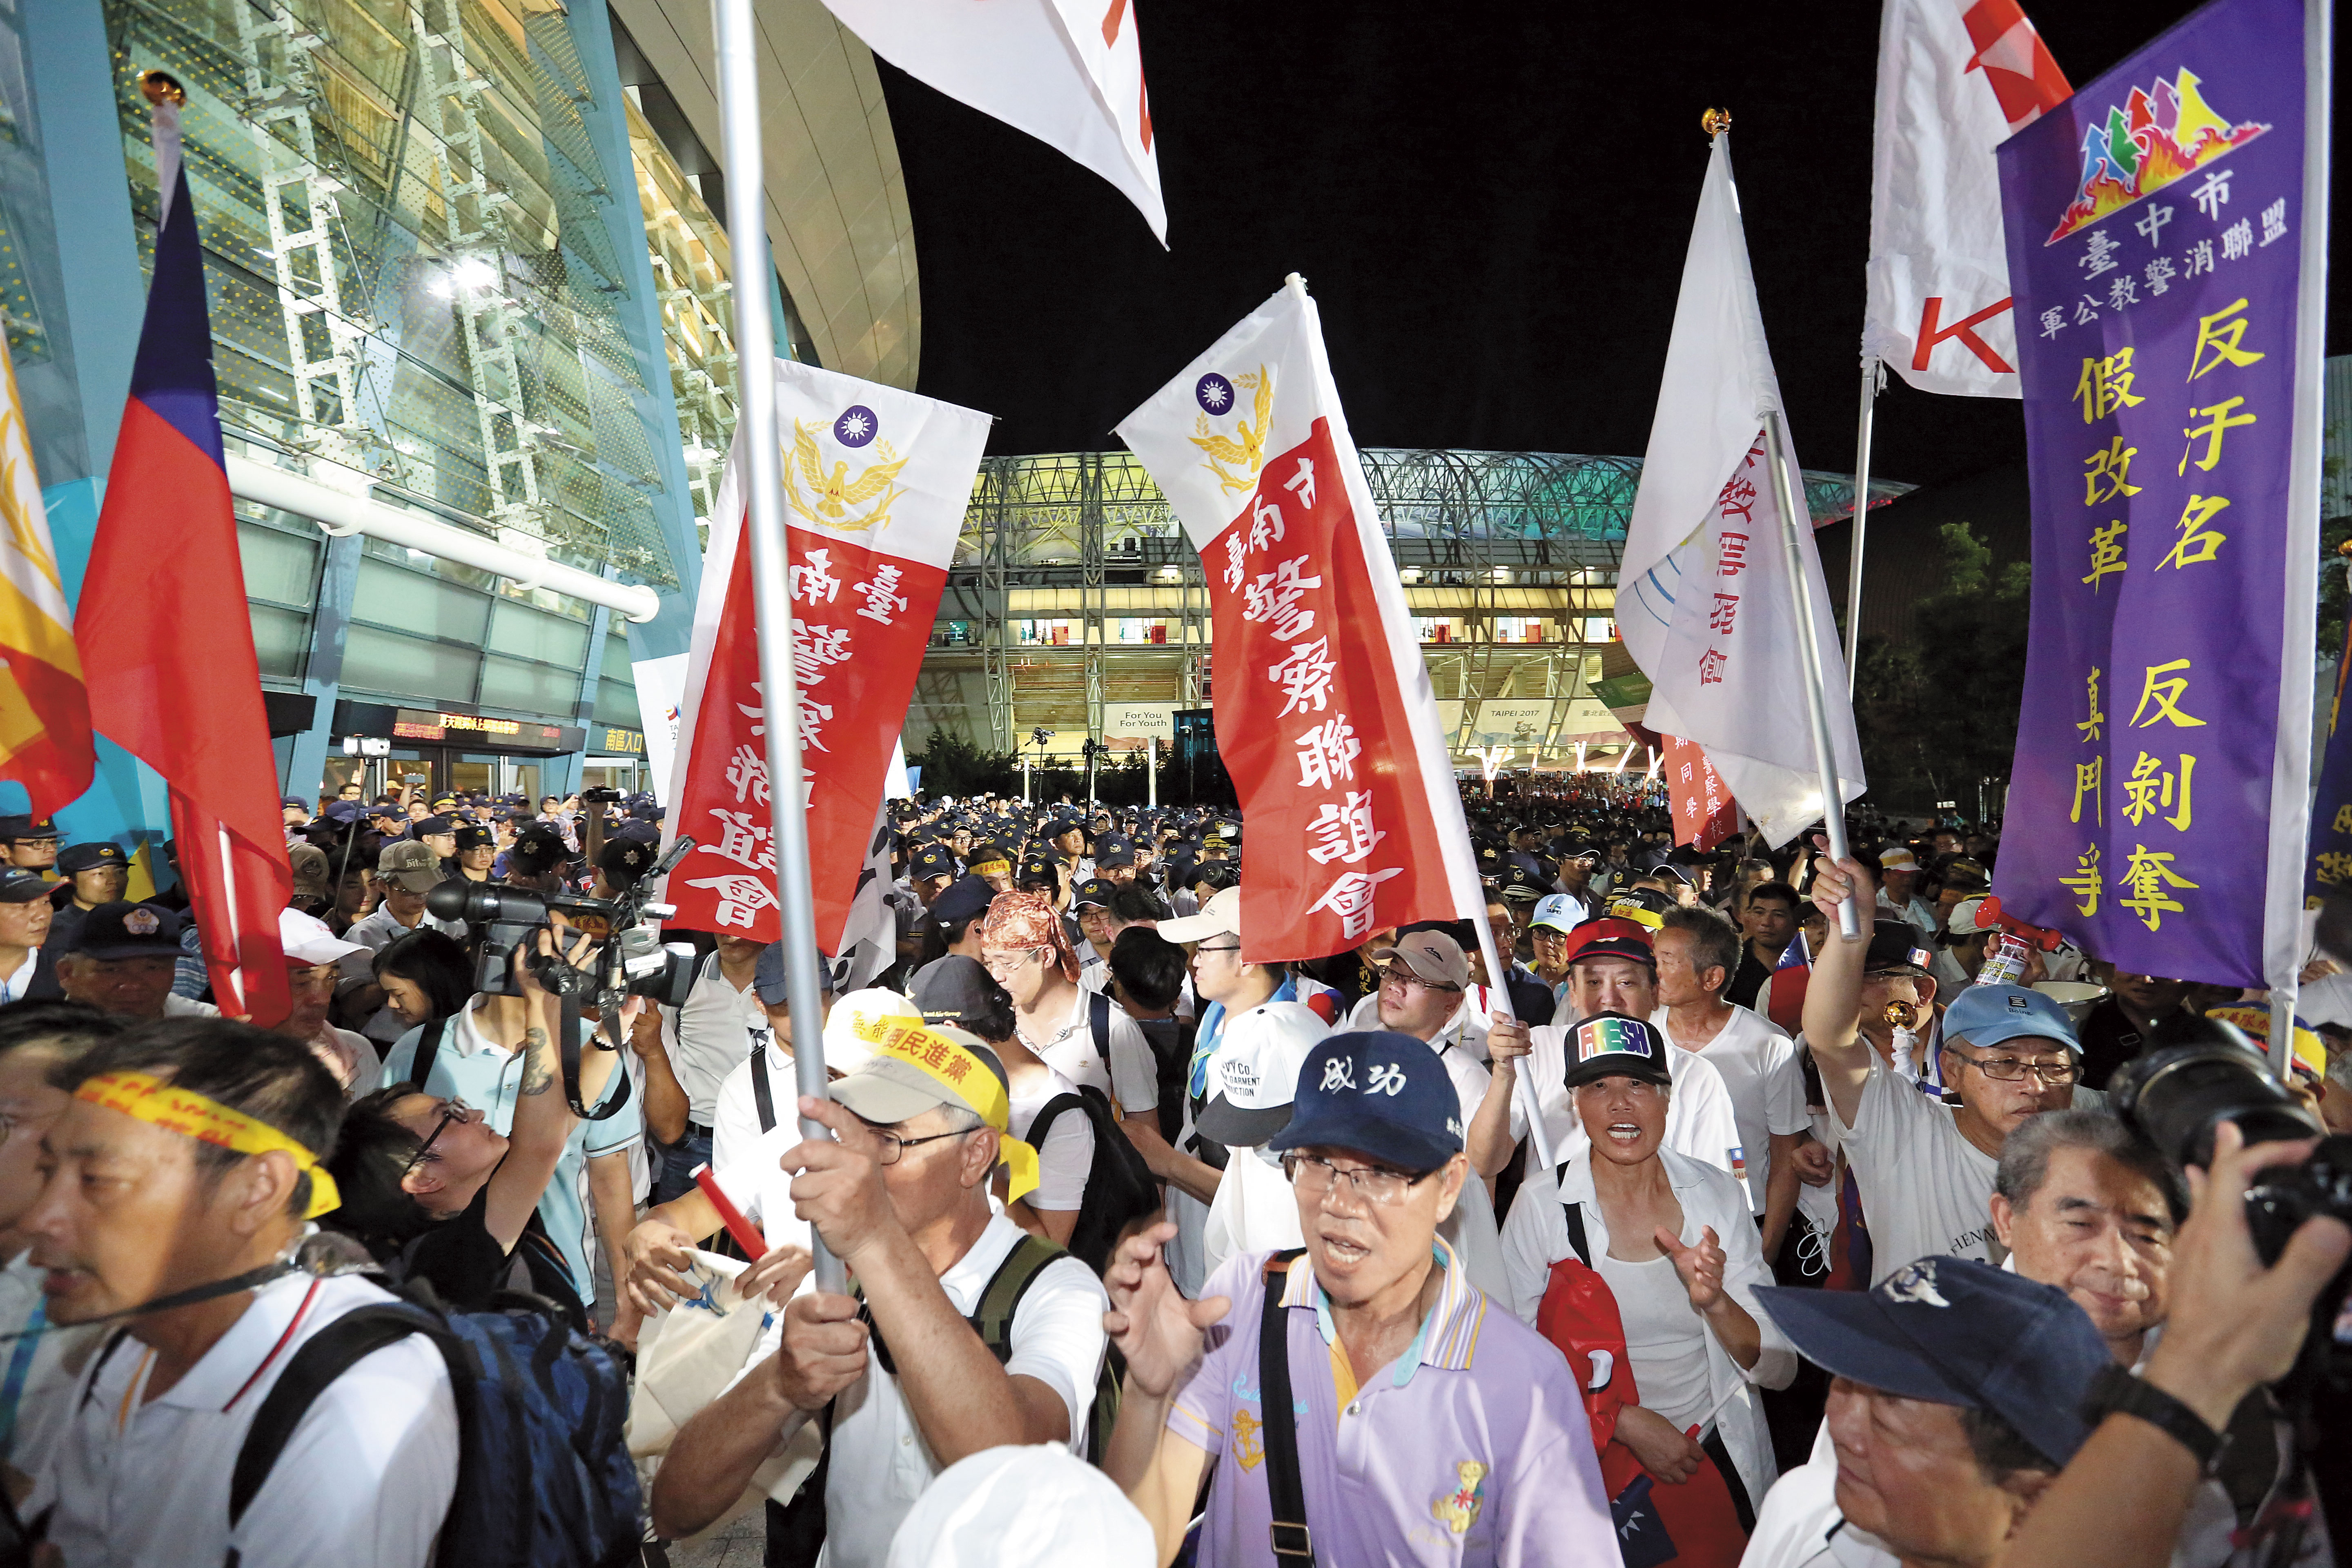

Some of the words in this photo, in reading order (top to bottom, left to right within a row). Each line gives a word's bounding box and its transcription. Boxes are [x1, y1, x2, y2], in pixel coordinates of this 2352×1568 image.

[2039, 198, 2287, 340] 軍公教警消聯盟
[2078, 169, 2233, 281] 臺中市
[2072, 346, 2146, 595] 假改革
[605, 728, 643, 753] 南區入口
[1242, 553, 1404, 940] 警察聯誼會
[1319, 1055, 1408, 1097] 成功
[1579, 1021, 1650, 1062] FRESH
